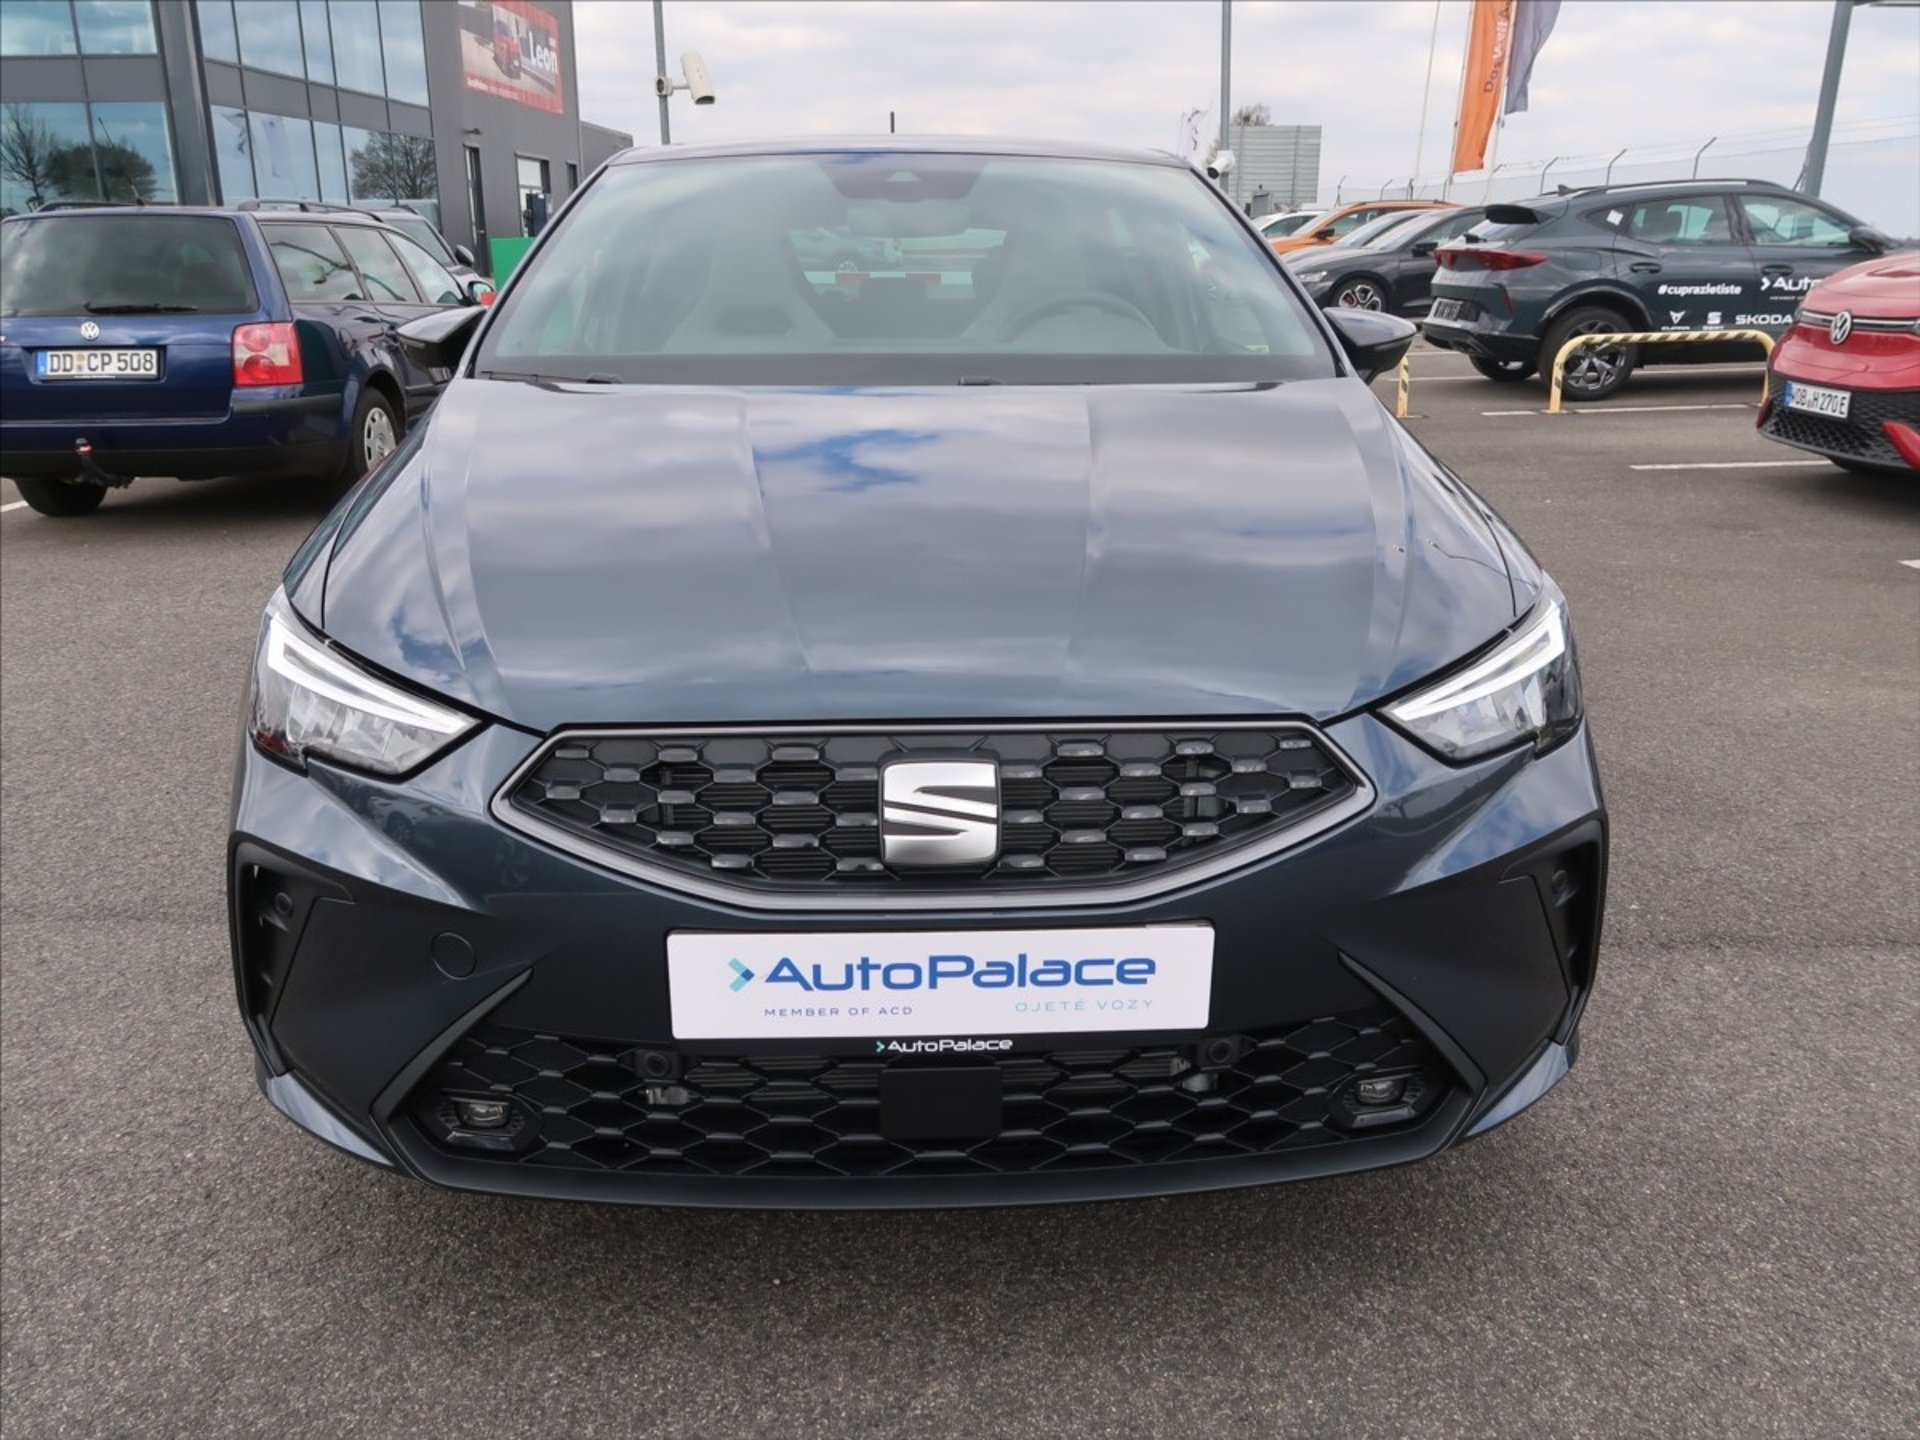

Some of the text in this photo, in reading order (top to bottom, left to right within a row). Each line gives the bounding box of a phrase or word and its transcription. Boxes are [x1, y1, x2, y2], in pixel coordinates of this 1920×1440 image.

[49, 352, 154, 373] DD CP 508
[765, 953, 1156, 991] AutoPalace
[764, 1006, 913, 1017] MEMBER OF ACD
[1015, 998, 1154, 1013] OJETÉ VOZY
[887, 1038, 1013, 1053] AutoPalace
